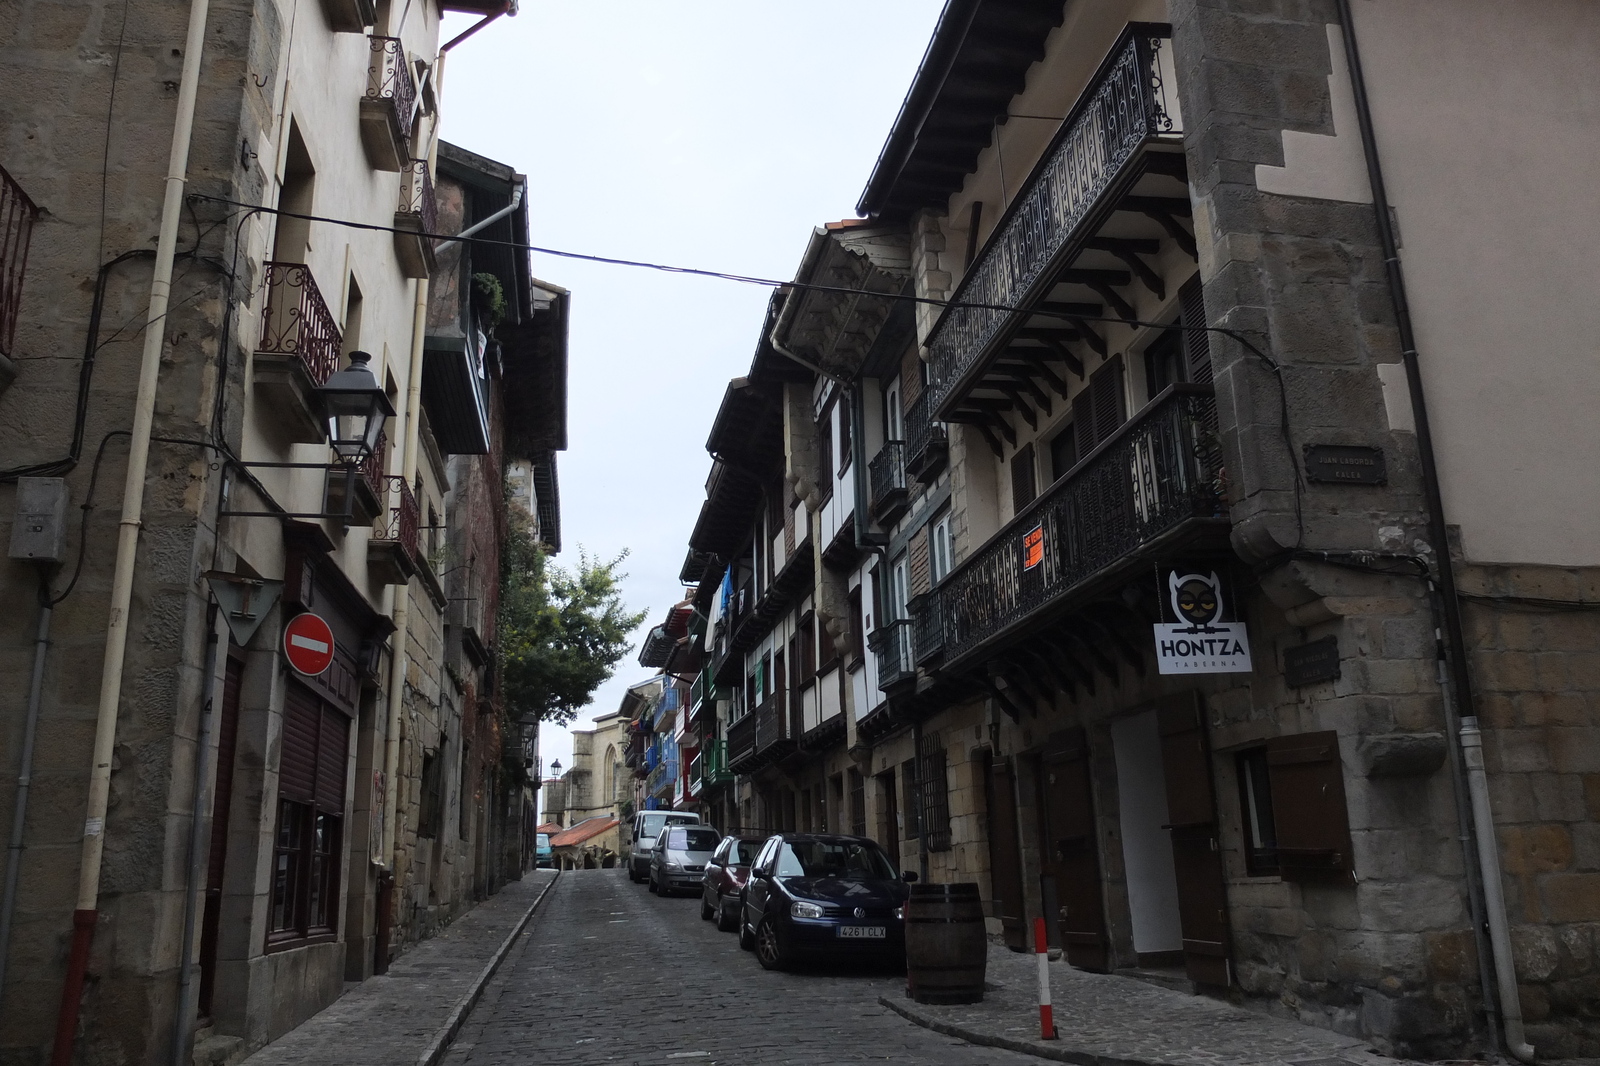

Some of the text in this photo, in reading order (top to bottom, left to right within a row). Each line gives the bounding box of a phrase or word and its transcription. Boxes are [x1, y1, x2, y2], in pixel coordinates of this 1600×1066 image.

[1161, 639, 1245, 657] HONTZA
[843, 927, 884, 936] 4261 CLX
